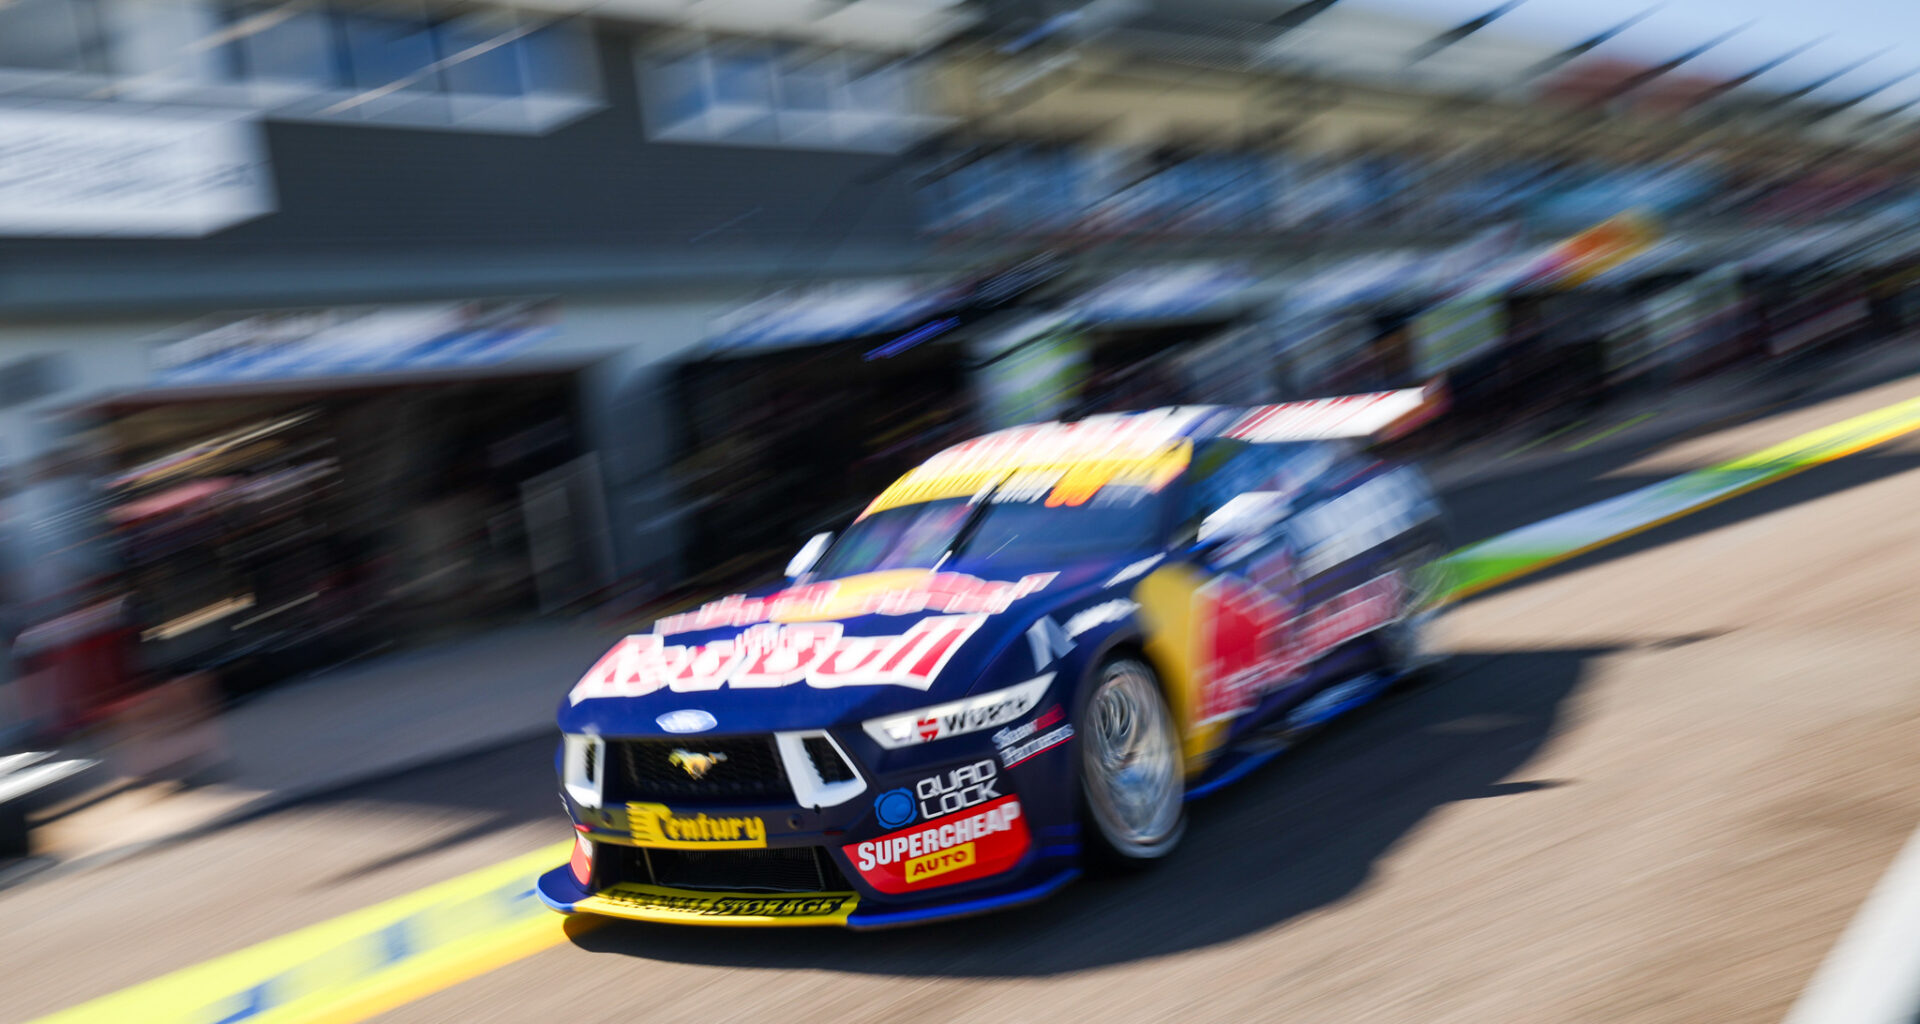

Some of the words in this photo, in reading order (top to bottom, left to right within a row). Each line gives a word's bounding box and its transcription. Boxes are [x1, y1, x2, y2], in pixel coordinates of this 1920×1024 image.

[729, 615, 988, 690] Bull
[917, 759, 998, 800] QUAD
[920, 778, 1002, 819] LOCK
[626, 801, 767, 850] Century
[858, 801, 1021, 871] SUPERCHEAP
[913, 850, 968, 876] AUTO
[706, 897, 847, 916] STORAGE
